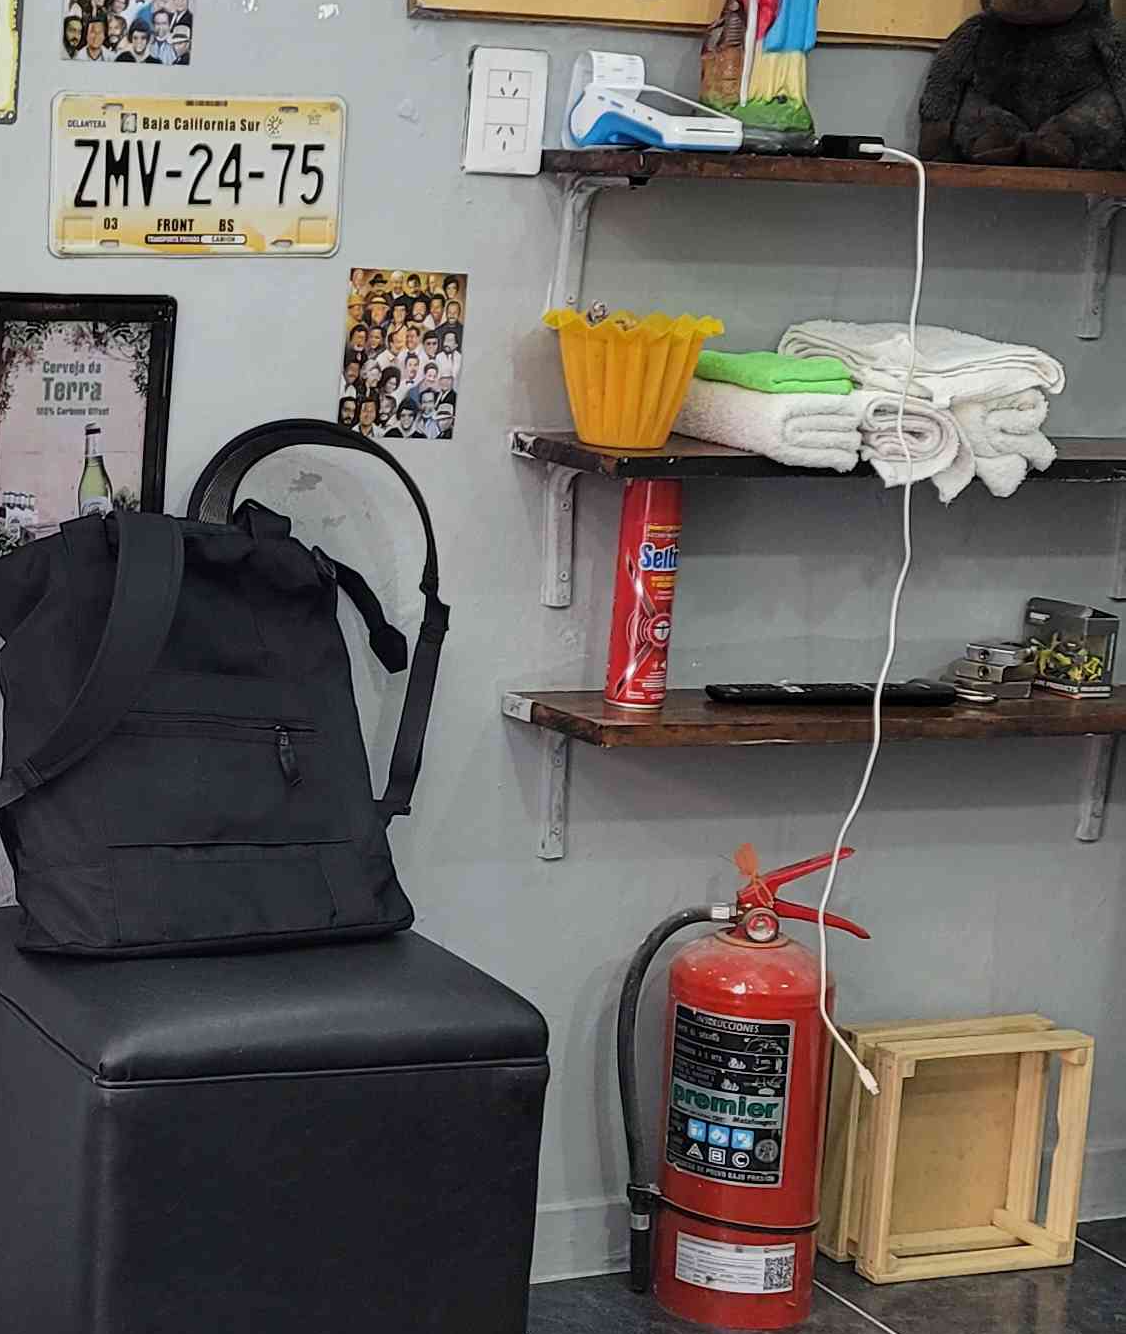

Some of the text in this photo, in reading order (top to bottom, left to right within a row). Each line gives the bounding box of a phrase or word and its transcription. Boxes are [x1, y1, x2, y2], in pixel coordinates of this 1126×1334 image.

[67, 119, 107, 129] DELANTERA
[142, 118, 261, 132] Baja California Sur
[73, 139, 326, 208] ZMV-24-75
[103, 218, 235, 233] 03 FRONT BS
[42, 360, 102, 376] Cerveja da
[42, 377, 103, 401] Terra
[673, 1082, 779, 1119] premier
